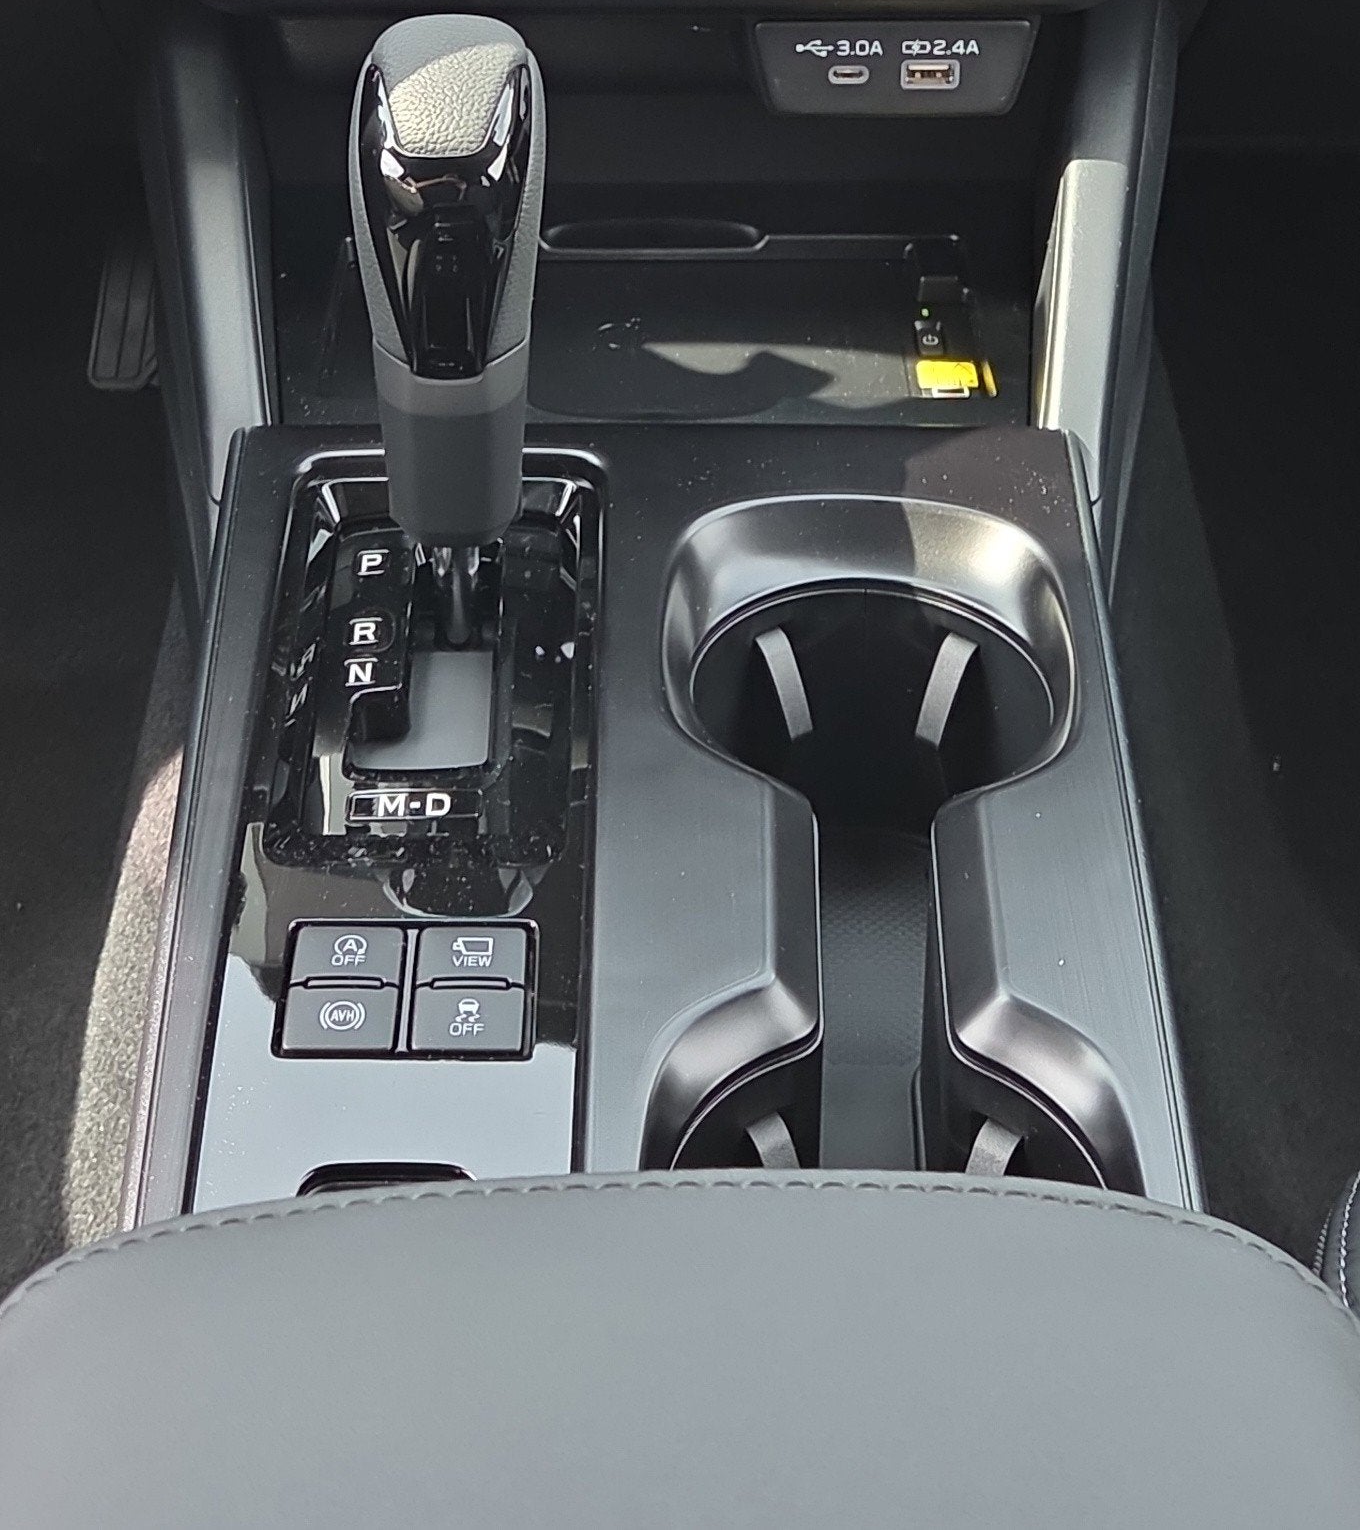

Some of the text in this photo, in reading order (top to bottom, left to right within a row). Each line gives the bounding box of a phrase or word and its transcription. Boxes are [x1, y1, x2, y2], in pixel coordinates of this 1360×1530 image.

[836, 40, 883, 56] 3.0A
[932, 39, 980, 56] 2.4A
[360, 553, 384, 572] P
[353, 623, 377, 642] R
[348, 663, 373, 683] N
[331, 954, 367, 966] OFF
[452, 955, 493, 967] VIEW
[330, 1009, 355, 1022] AVH
[449, 1023, 485, 1036] OFF
